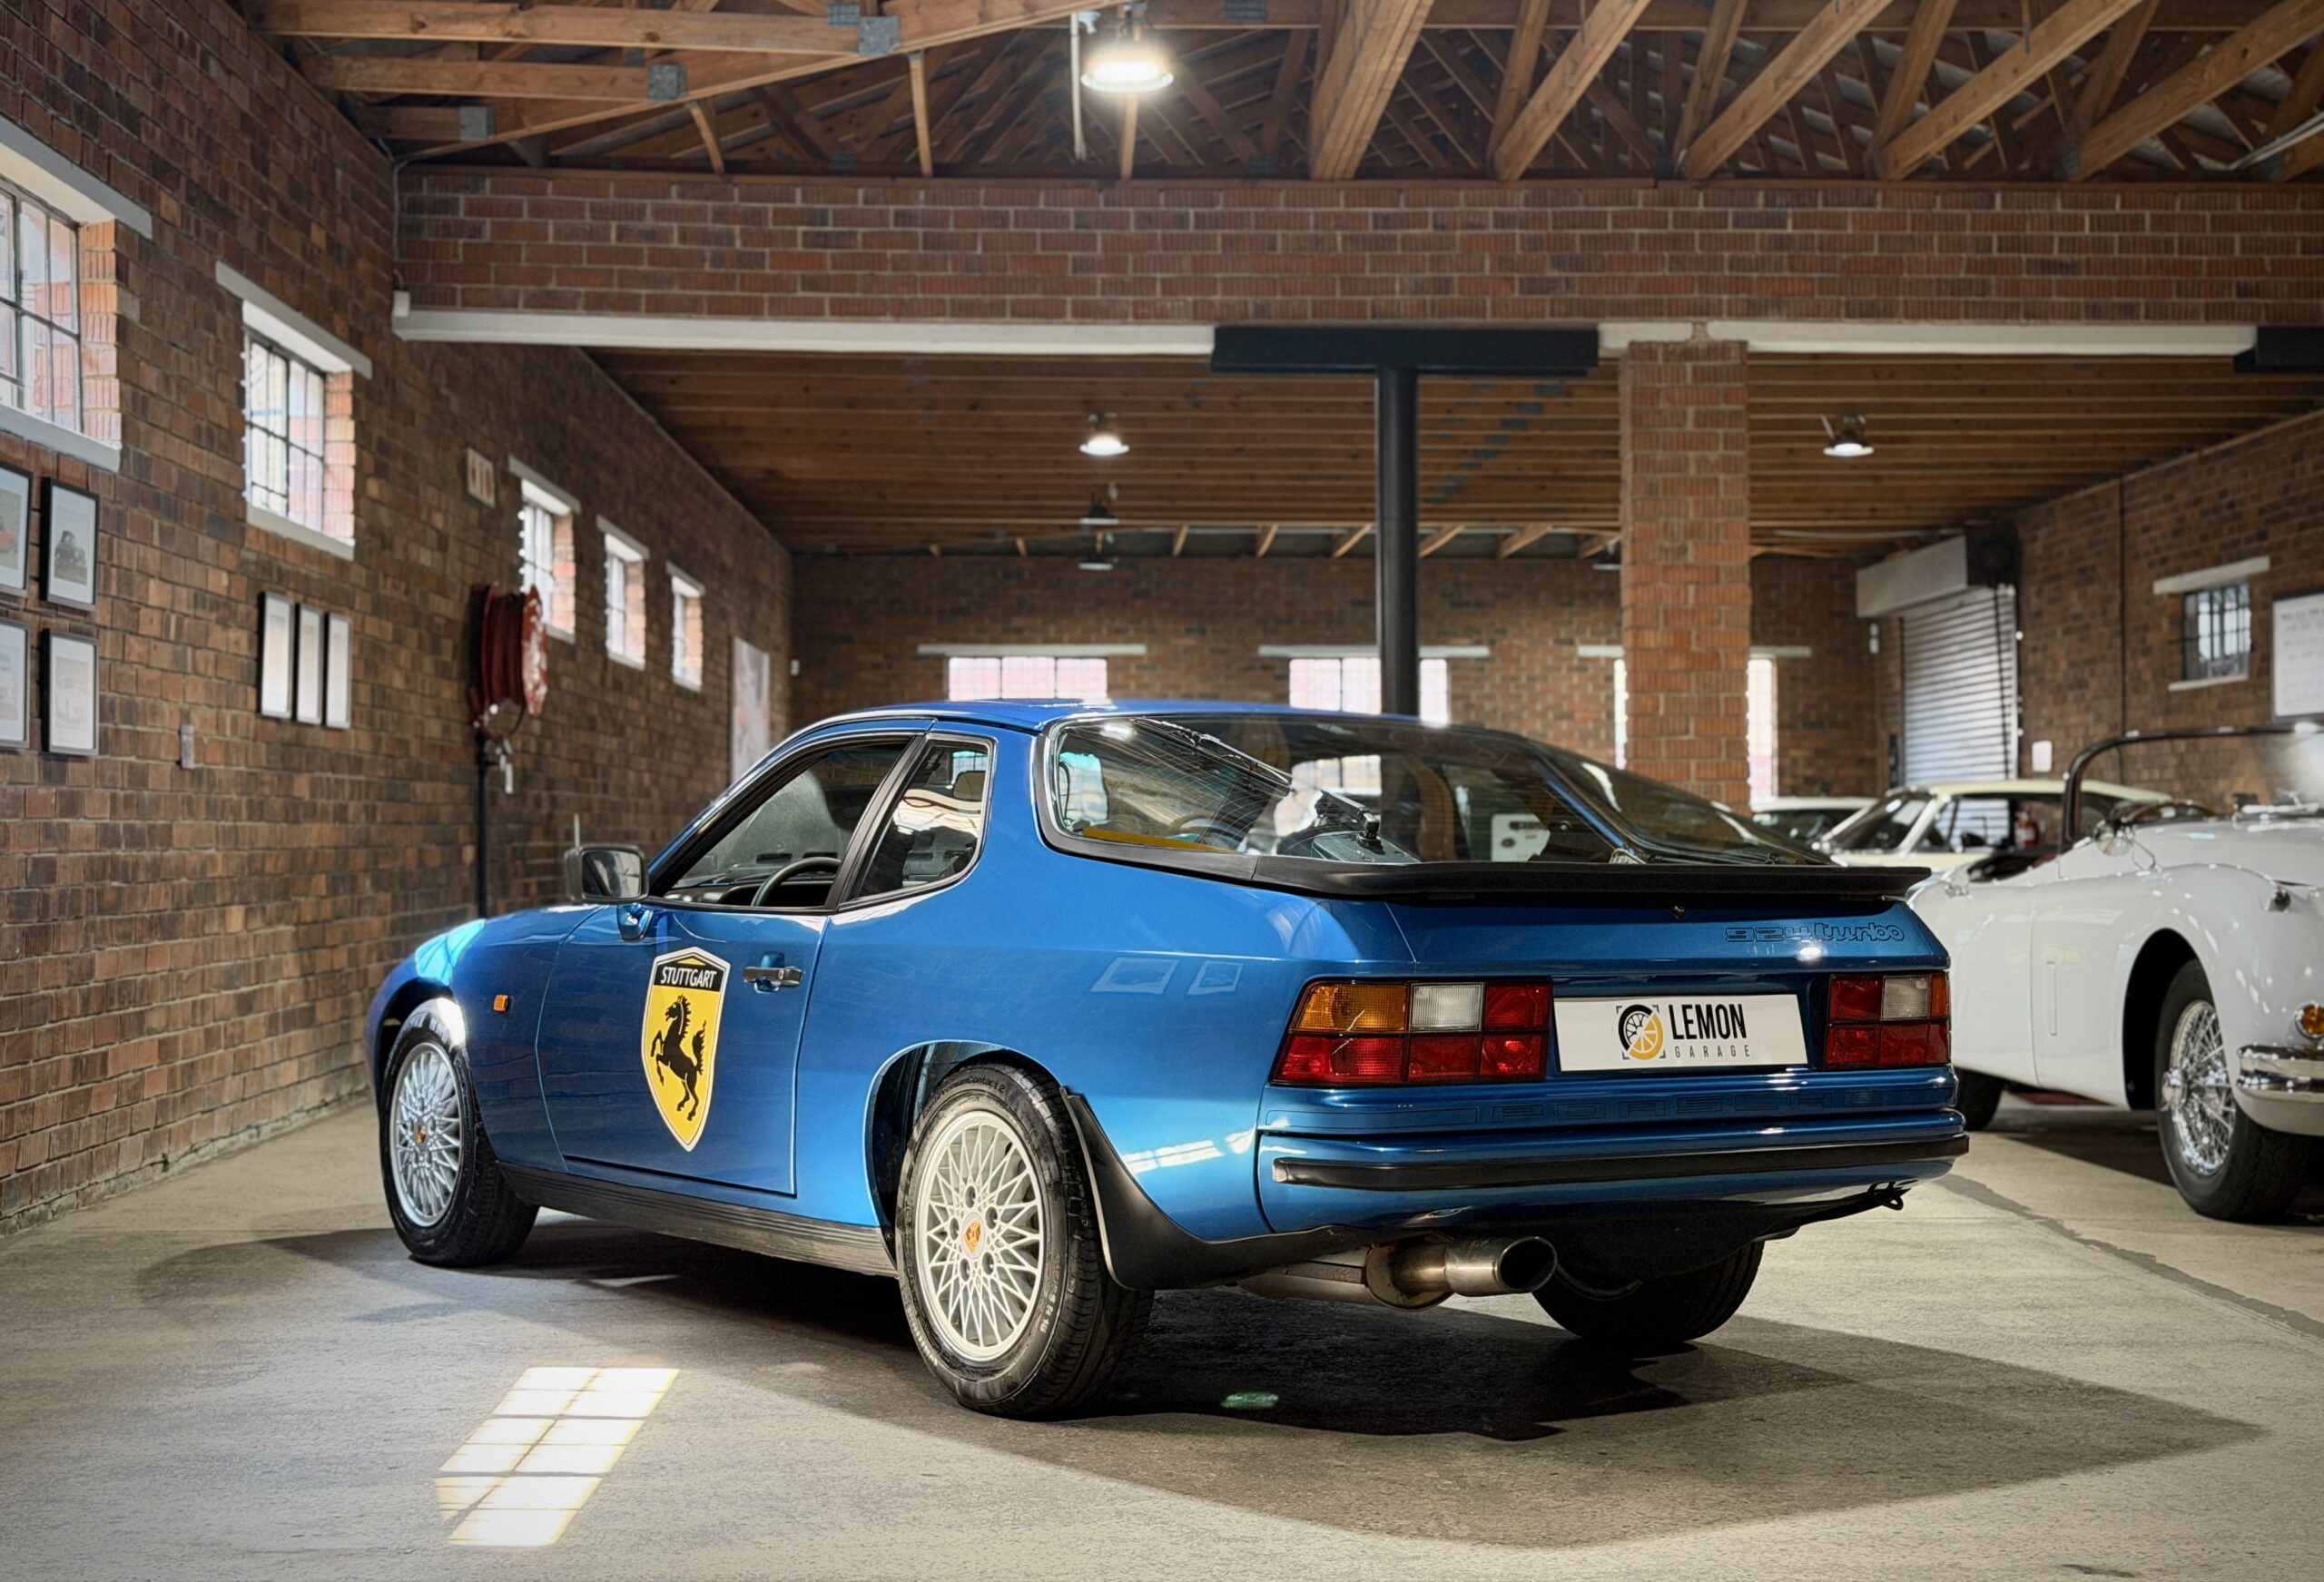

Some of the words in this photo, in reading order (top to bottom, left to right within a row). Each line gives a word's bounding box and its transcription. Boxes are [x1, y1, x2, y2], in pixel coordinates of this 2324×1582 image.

[1726, 927, 1811, 943] 924
[1814, 922, 1905, 942] turbo
[660, 966, 717, 989] STUTTGART
[1668, 1003, 1748, 1040] LEMON
[1675, 1044, 1751, 1058] GARAGE
